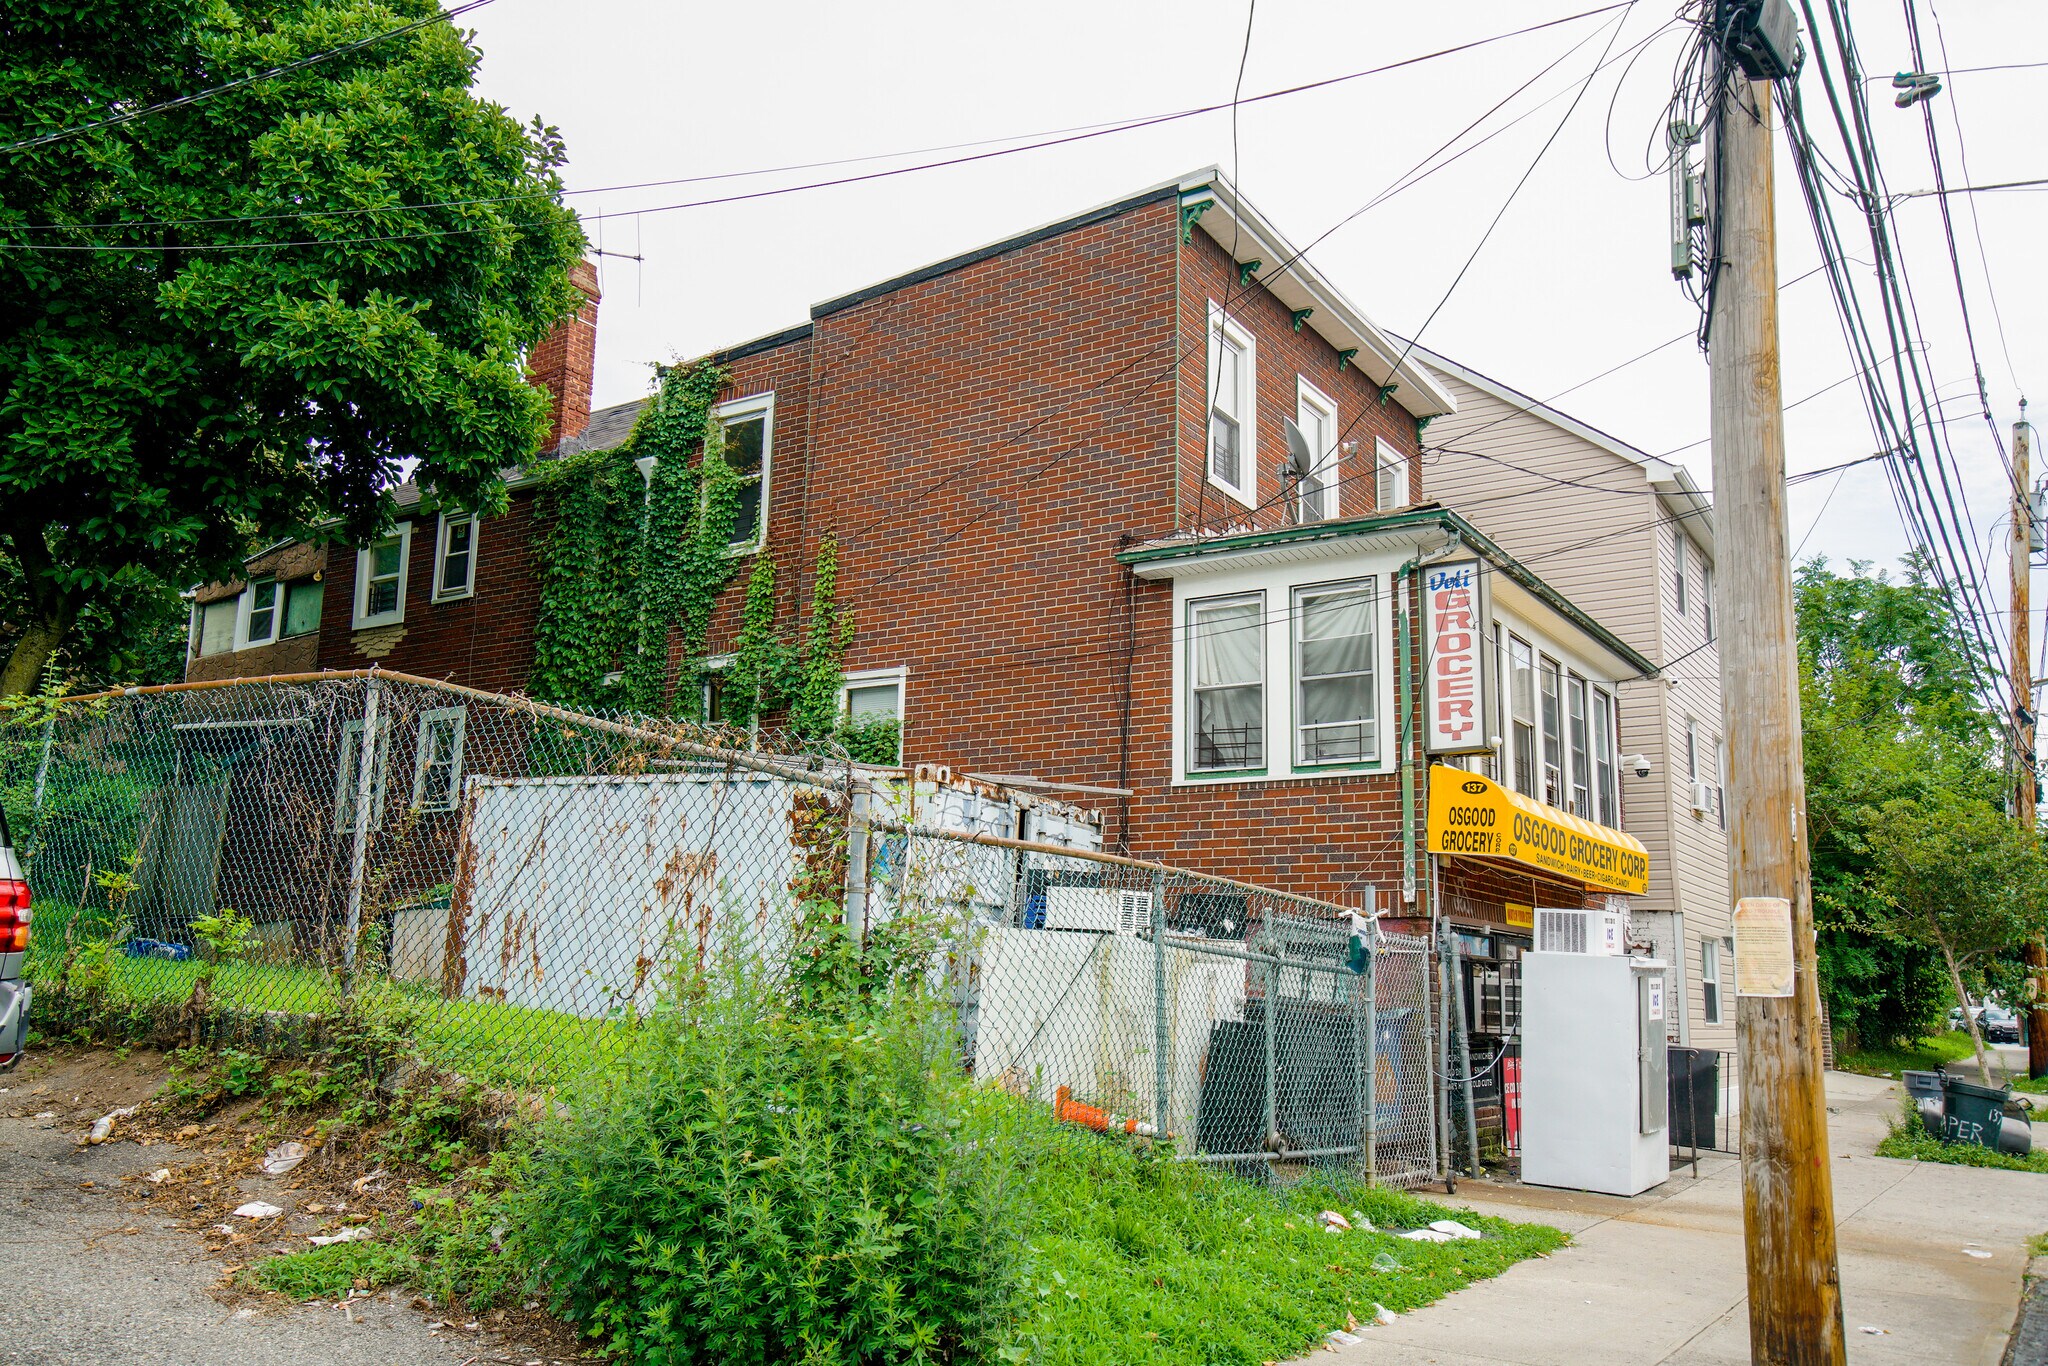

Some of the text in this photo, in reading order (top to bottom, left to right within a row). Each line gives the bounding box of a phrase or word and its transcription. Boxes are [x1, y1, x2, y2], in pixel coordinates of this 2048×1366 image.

[1429, 569, 1474, 591] Deli
[1434, 588, 1474, 741] GROCERY
[1465, 783, 1484, 793] 137
[1449, 806, 1496, 827] OSGOOD
[1441, 830, 1494, 853] GROCERY
[1513, 813, 1566, 856] OSGOOD
[1569, 834, 1619, 873] GROCERY
[1535, 853, 1564, 871] SANDWICH
[1566, 863, 1582, 876] DAIRY
[1583, 868, 1596, 879] BEER
[1597, 873, 1614, 885] CIGARS
